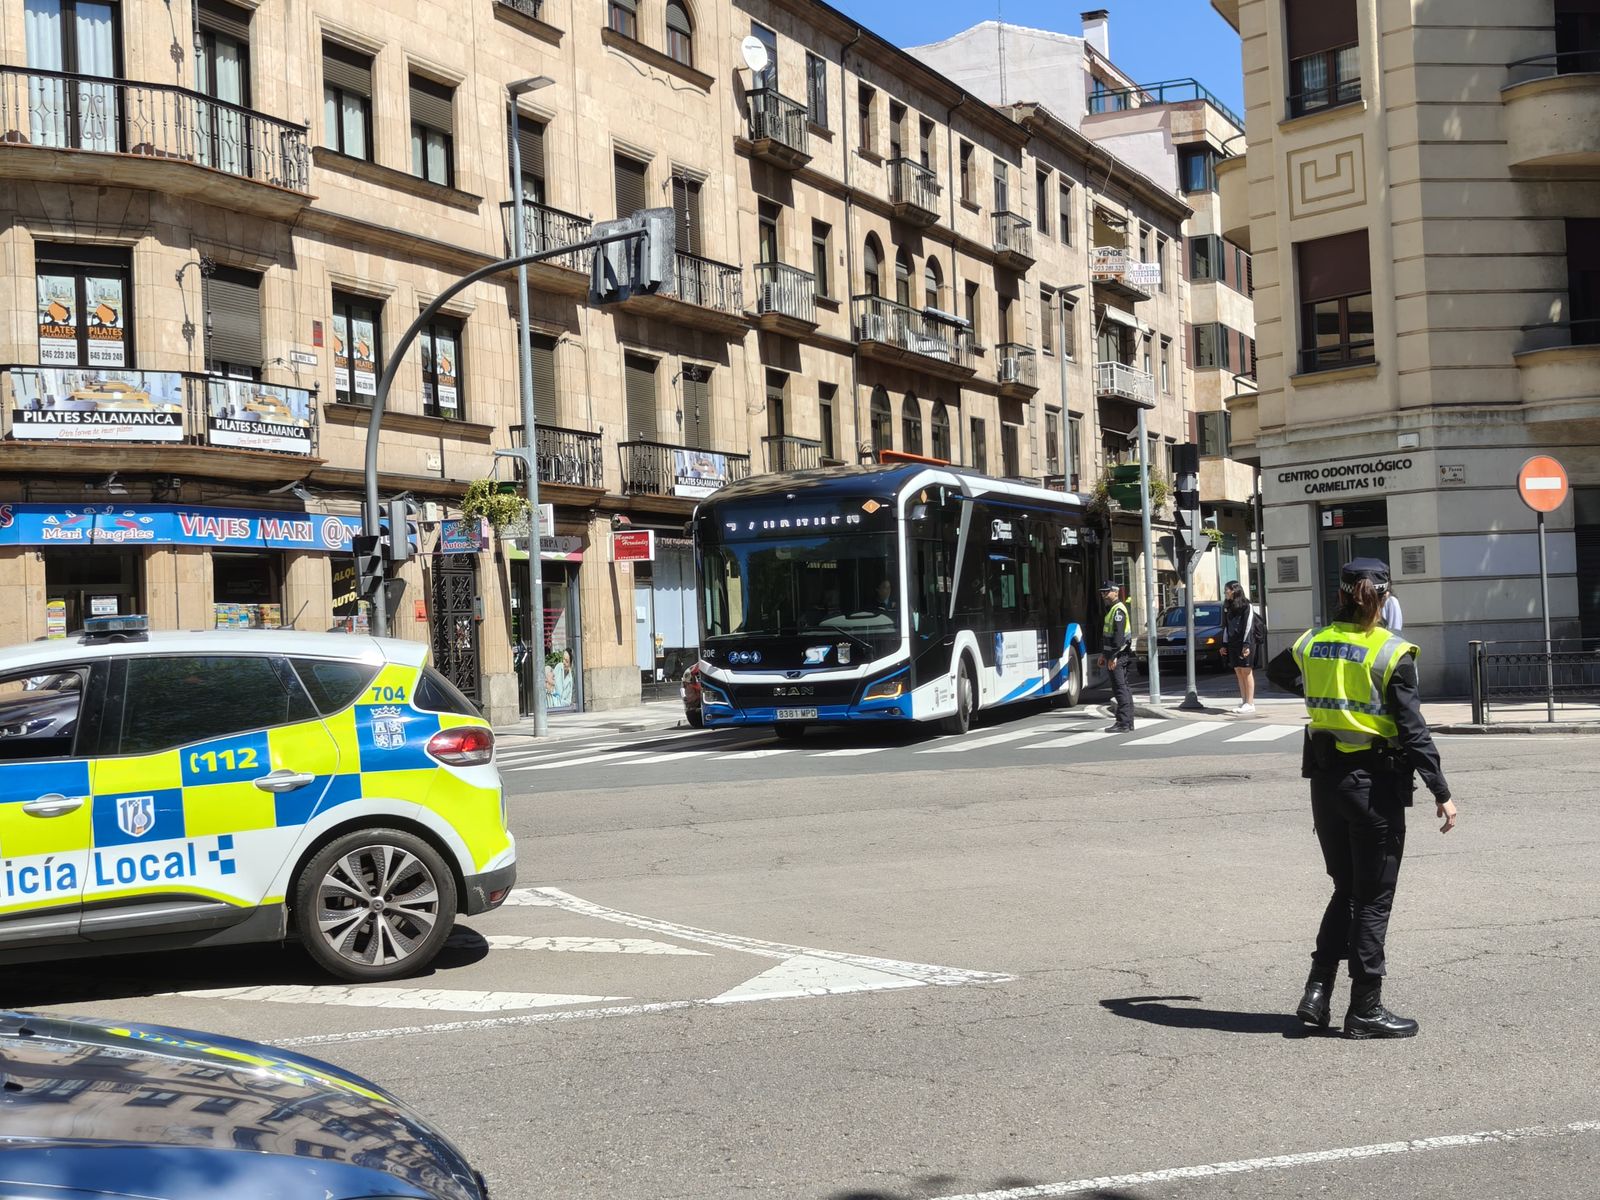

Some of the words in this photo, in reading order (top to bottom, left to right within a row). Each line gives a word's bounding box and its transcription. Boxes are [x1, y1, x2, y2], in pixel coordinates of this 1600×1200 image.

[41, 325, 76, 335] PILATES
[89, 326, 123, 336] PILATES
[23, 411, 81, 423] PILATES
[83, 412, 175, 425] SALAMANCA
[215, 418, 251, 432] PILATES
[251, 422, 306, 438] SALAMANCA
[1278, 469, 1319, 483] CENTRO
[1321, 458, 1413, 478] ODONTOLÓGICO
[1304, 477, 1370, 494] CARMELITAS
[1372, 476, 1385, 487] 10
[42, 527, 82, 539] Mari
[86, 527, 154, 542] @ngeles
[177, 512, 250, 541] VIAJES
[256, 517, 314, 542] MARI
[332, 591, 359, 608] AUTO
[805, 645, 832, 664] ST
[372, 686, 405, 701] 704
[773, 686, 814, 696] MAN
[779, 709, 799, 718] 8381
[200, 748, 258, 773] 112
[0, 857, 77, 897] icía
[94, 843, 197, 886] Local
